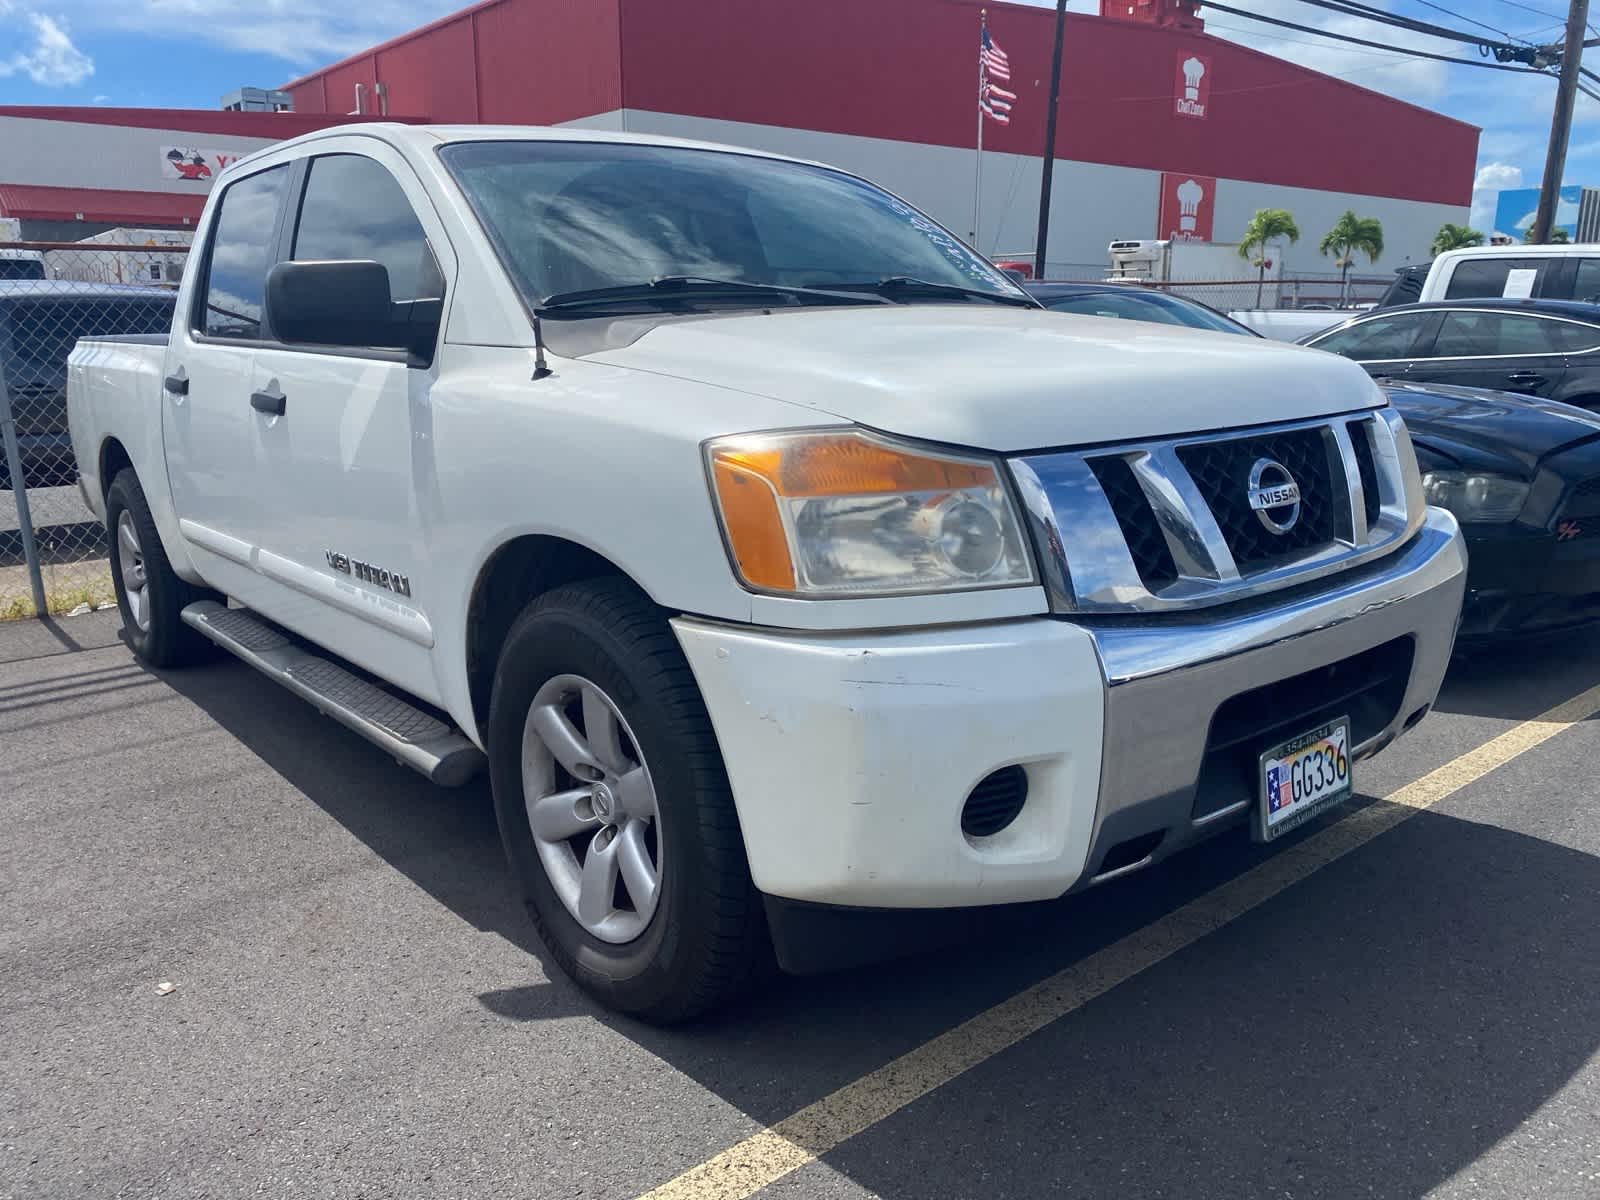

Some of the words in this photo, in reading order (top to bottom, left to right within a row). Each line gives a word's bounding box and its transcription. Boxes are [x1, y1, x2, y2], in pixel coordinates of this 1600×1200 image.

[1259, 487, 1298, 505] NISSAN
[325, 549, 351, 576] V8
[351, 559, 411, 599] TITAN
[1291, 738, 1347, 804] GG336
